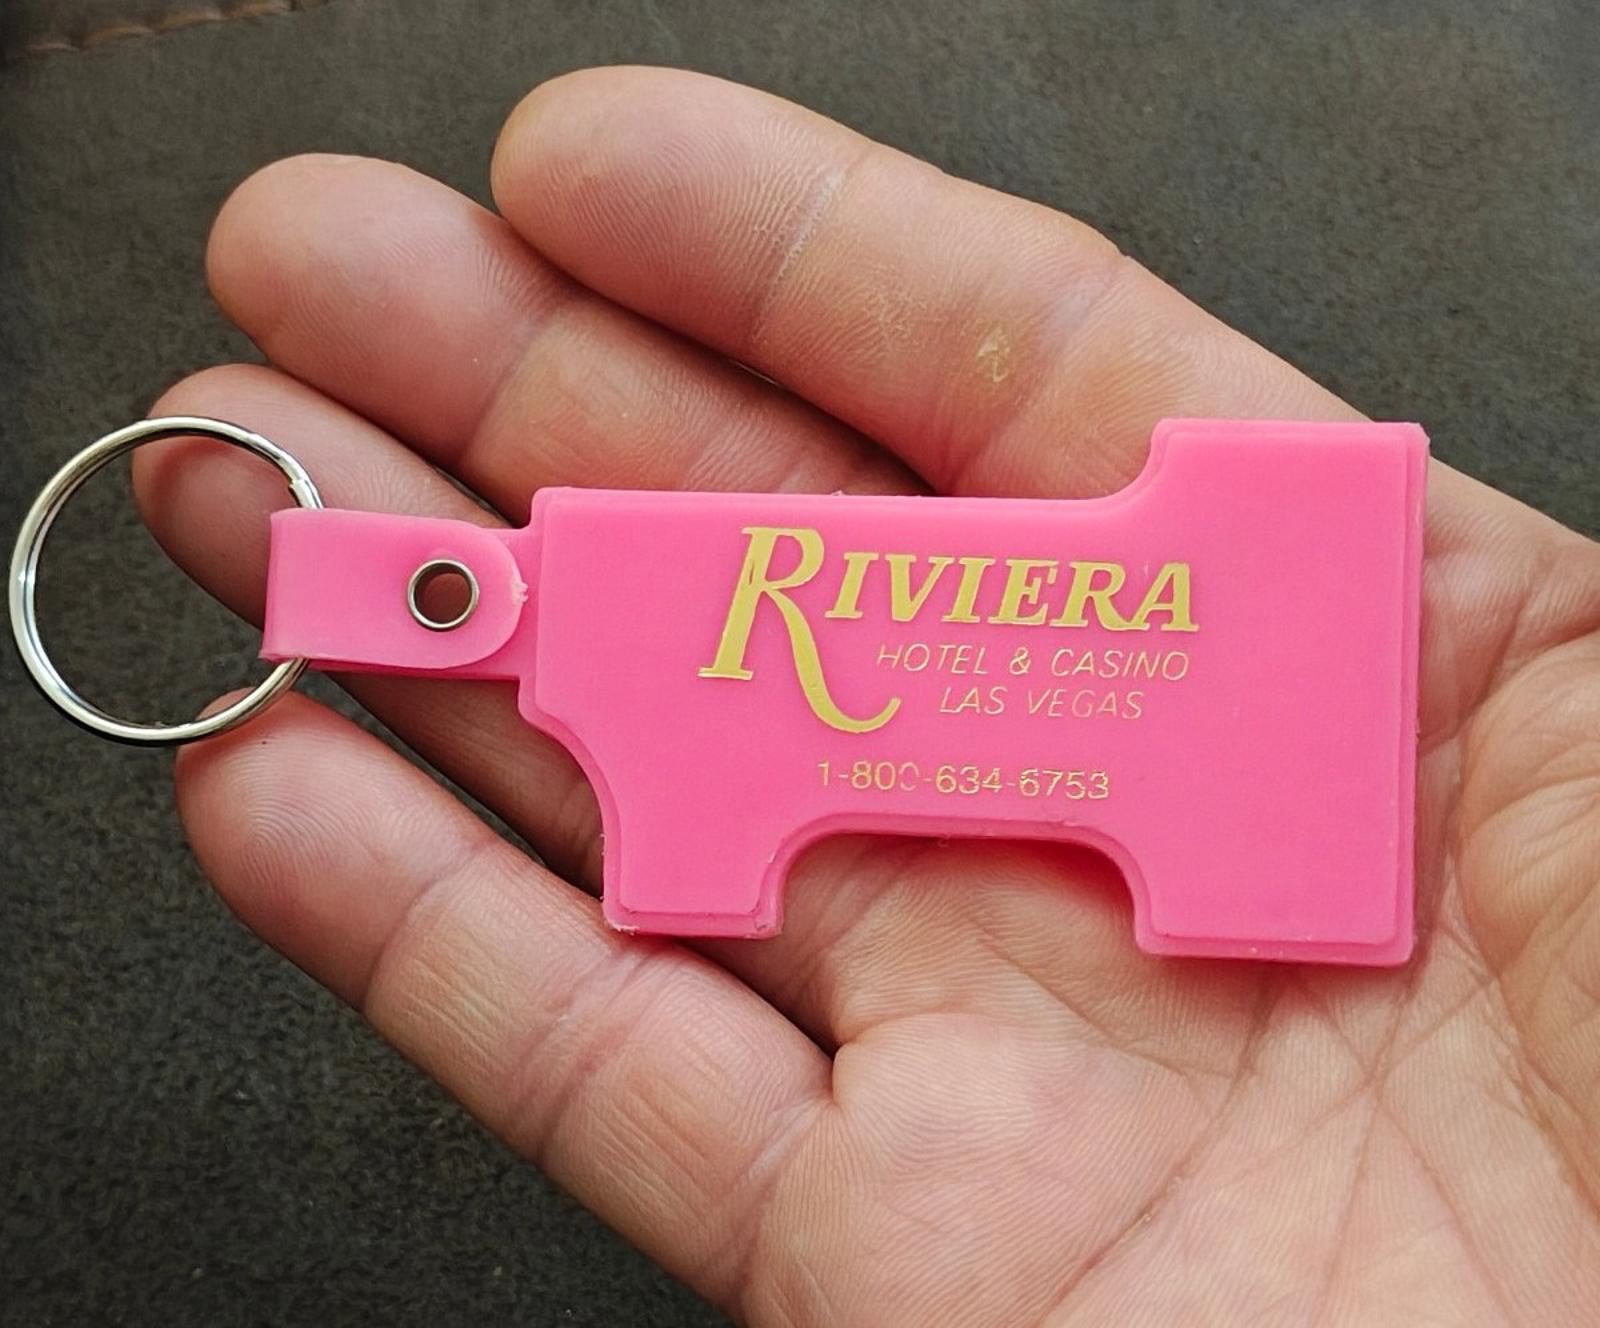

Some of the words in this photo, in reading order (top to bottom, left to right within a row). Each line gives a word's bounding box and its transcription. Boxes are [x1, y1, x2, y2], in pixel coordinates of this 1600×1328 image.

[698, 526, 1199, 734] RIVIERA
[877, 643, 989, 676] HOTEL
[1009, 646, 1032, 676] &
[1051, 648, 1190, 682] CASINO
[939, 685, 1008, 716] LAS
[1028, 688, 1146, 720] VEGAS
[817, 759, 1110, 801] 1-800-634-6753
